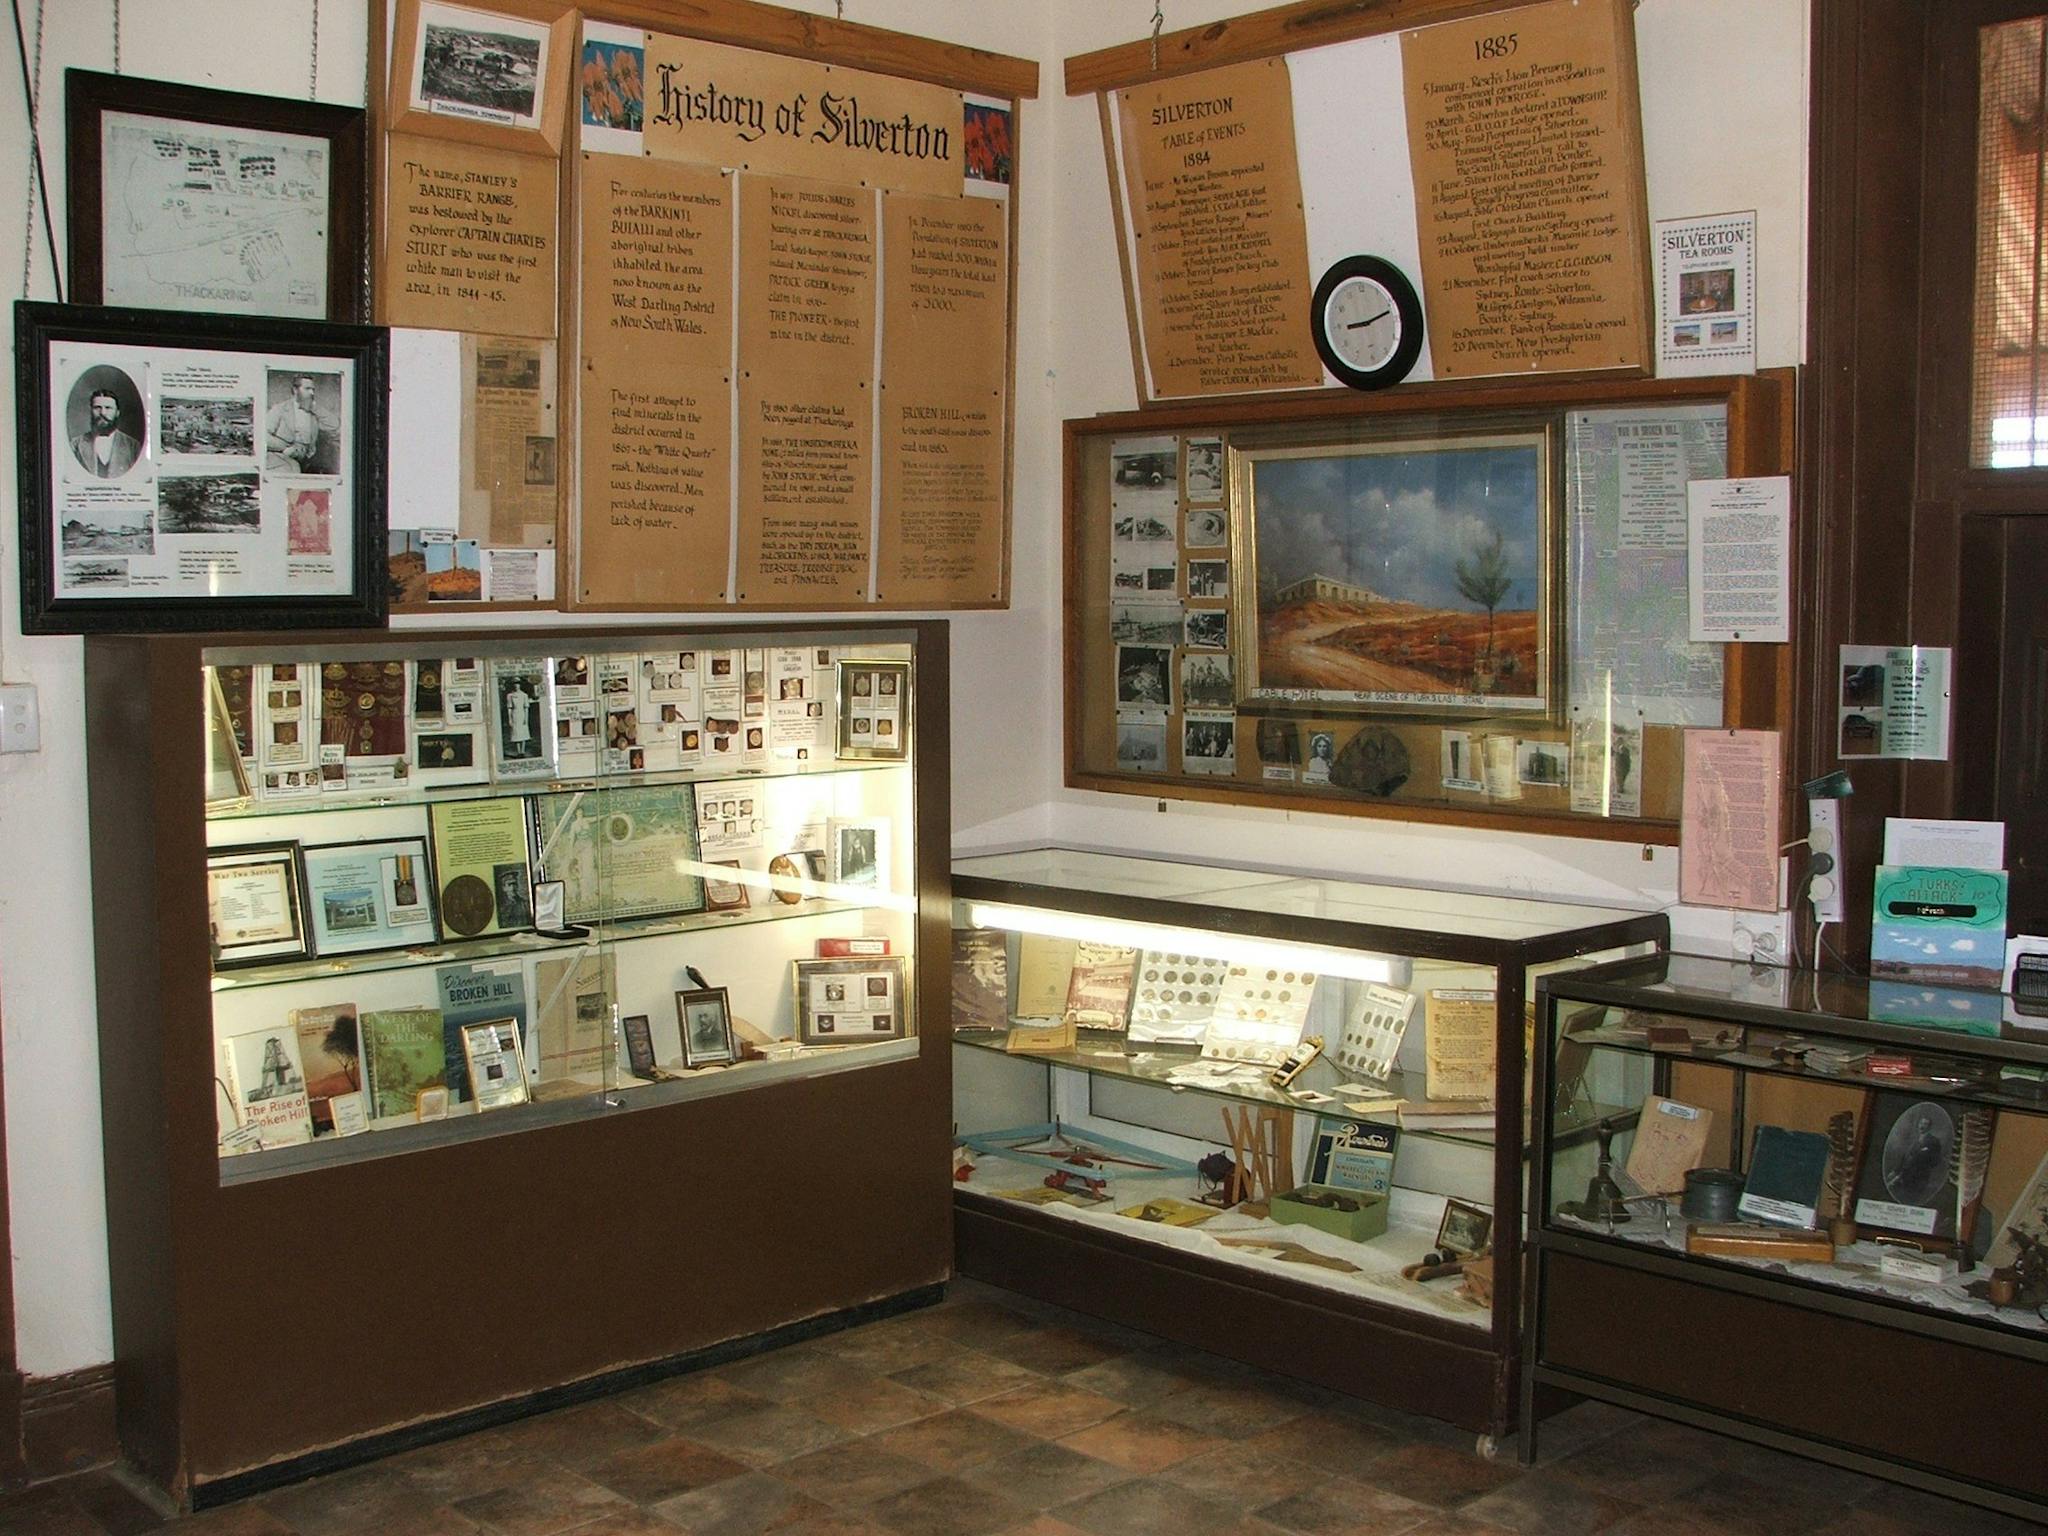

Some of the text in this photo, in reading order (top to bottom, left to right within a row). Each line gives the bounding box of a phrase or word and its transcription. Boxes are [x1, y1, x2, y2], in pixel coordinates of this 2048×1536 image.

[1475, 33, 1519, 61] 1885
[1531, 62, 1572, 76] Brewery
[653, 63, 951, 161] History of Silverton
[1152, 97, 1233, 126] SILVERTON
[1469, 102, 1548, 122] Silverton declared
[1437, 115, 1536, 138] April Lodge
[1545, 118, 1588, 131] Silverton
[1161, 131, 1194, 150] TABLE
[1208, 123, 1246, 141] EVENTS
[1183, 152, 1211, 168] 1884
[1498, 147, 1539, 160] Silverton
[1502, 154, 1554, 168] Australian
[404, 162, 430, 184] The
[1464, 163, 1568, 187] Silverton Football Club
[420, 184, 472, 202] BARRIER
[631, 188, 721, 207] centuries the members
[1495, 191, 1609, 213] Christian Church opened
[409, 205, 512, 225] was bestowed by the
[613, 206, 640, 217] of the
[1494, 210, 1567, 226] Church Building
[656, 227, 702, 239] and other
[1544, 219, 1579, 233] Sydney
[409, 224, 546, 249] explorer CAPTAIN CHARLES
[1667, 230, 1745, 250] SILVERTON
[406, 241, 537, 269] STURT who was the first
[611, 241, 694, 256] aboriginal tribes
[1492, 242, 1579, 261] meeting held under
[1680, 246, 1734, 259] TEA ROOMS
[407, 260, 521, 284] white man to visit the
[665, 262, 704, 274] the area
[613, 276, 702, 293] now known as the
[1519, 273, 1543, 282] coach
[174, 284, 254, 302] THACKARINGA
[406, 283, 450, 296] area, in
[612, 293, 715, 316] West Darling District
[769, 310, 787, 321] THE
[621, 314, 707, 335] New South Wales.
[1511, 317, 1626, 335] Bank of opened
[820, 333, 855, 346] district.
[1516, 338, 1538, 347] New
[1492, 347, 1575, 361] Church opened.
[611, 389, 696, 411] The first attempt to
[612, 407, 702, 423] find minerals in the
[902, 406, 961, 421] BROKEN HILL
[612, 424, 695, 441] district occurred in
[638, 445, 651, 456] the
[636, 462, 704, 478] Nothing of value
[611, 481, 704, 497] was Men
[611, 499, 695, 516] perished because of
[611, 515, 643, 530] lack of
[1258, 690, 1322, 700] CABLE HOTEL
[450, 983, 513, 1002] BROKEN HILL
[393, 1023, 419, 1033] THE
[380, 1032, 434, 1043] DARLING
[244, 1096, 306, 1117] The Rise of
[247, 1107, 308, 1127] Boken Hill
